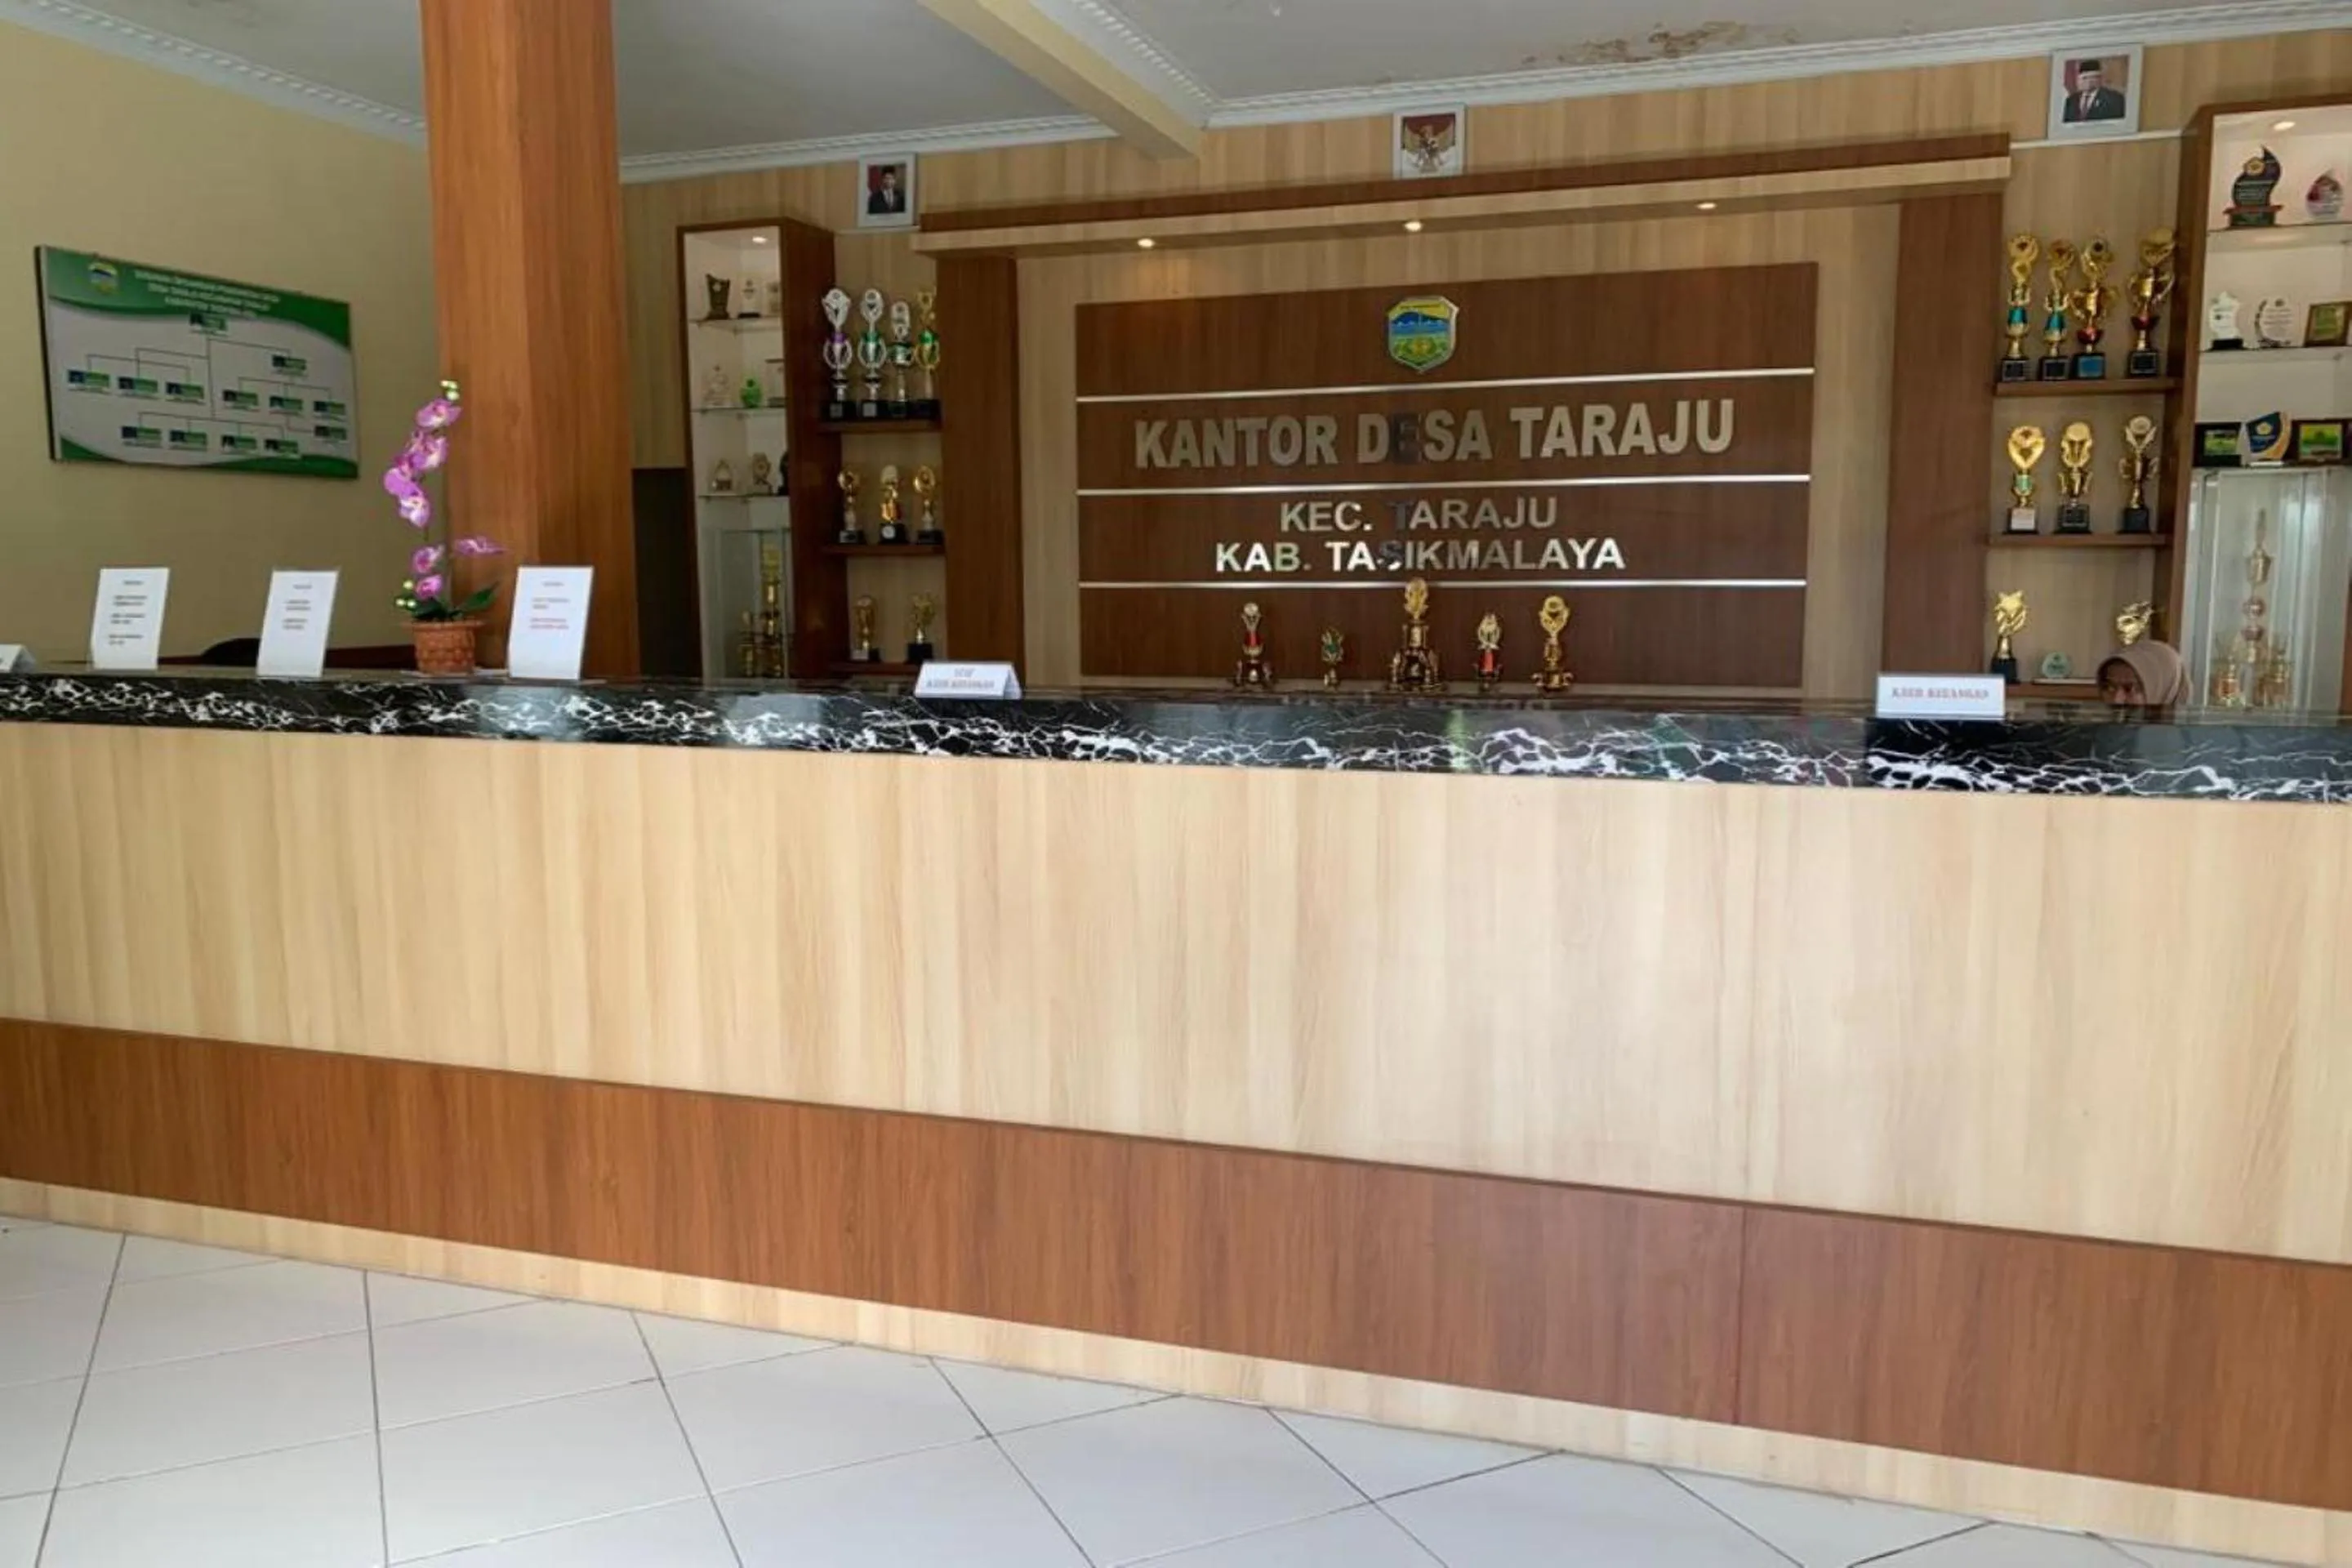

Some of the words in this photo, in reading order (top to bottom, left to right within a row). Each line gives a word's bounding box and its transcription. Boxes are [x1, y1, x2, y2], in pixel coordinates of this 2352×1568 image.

[1134, 414, 1339, 469] KANTOR
[1356, 408, 1493, 466] DESA
[1509, 399, 1735, 460] TARAJU
[1280, 501, 1373, 532] KEC.
[1390, 497, 1557, 530] TARAJU
[1215, 541, 1312, 572] KAB.
[1324, 537, 1626, 572] TASIKMALAYA
